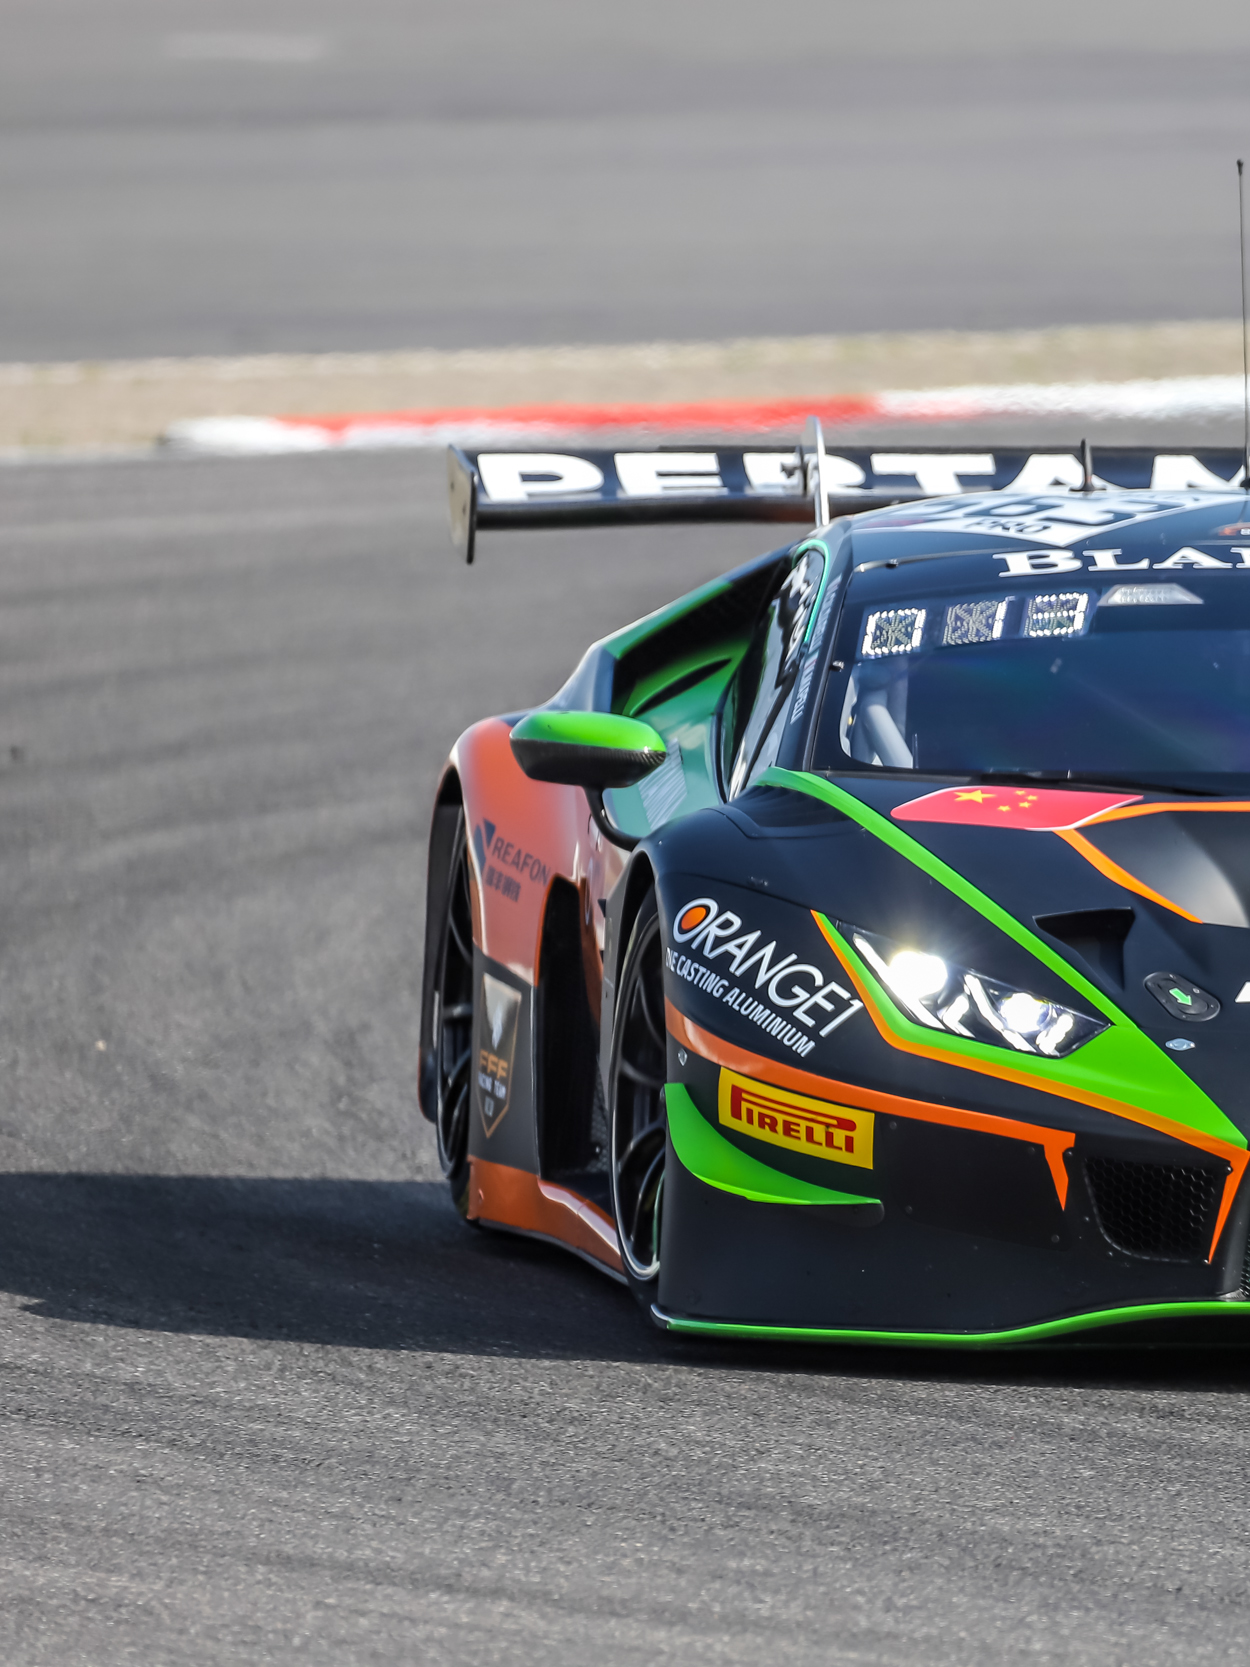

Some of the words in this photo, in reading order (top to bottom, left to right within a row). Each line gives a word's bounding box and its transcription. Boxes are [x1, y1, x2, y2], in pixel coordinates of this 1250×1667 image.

[491, 835, 551, 888] REAFON
[672, 897, 865, 1038] ORANGE1
[675, 952, 730, 998] CASTING
[722, 986, 816, 1058] ALUMINIUM
[479, 1047, 509, 1080] FFF
[730, 1083, 857, 1154] PIRELLI
